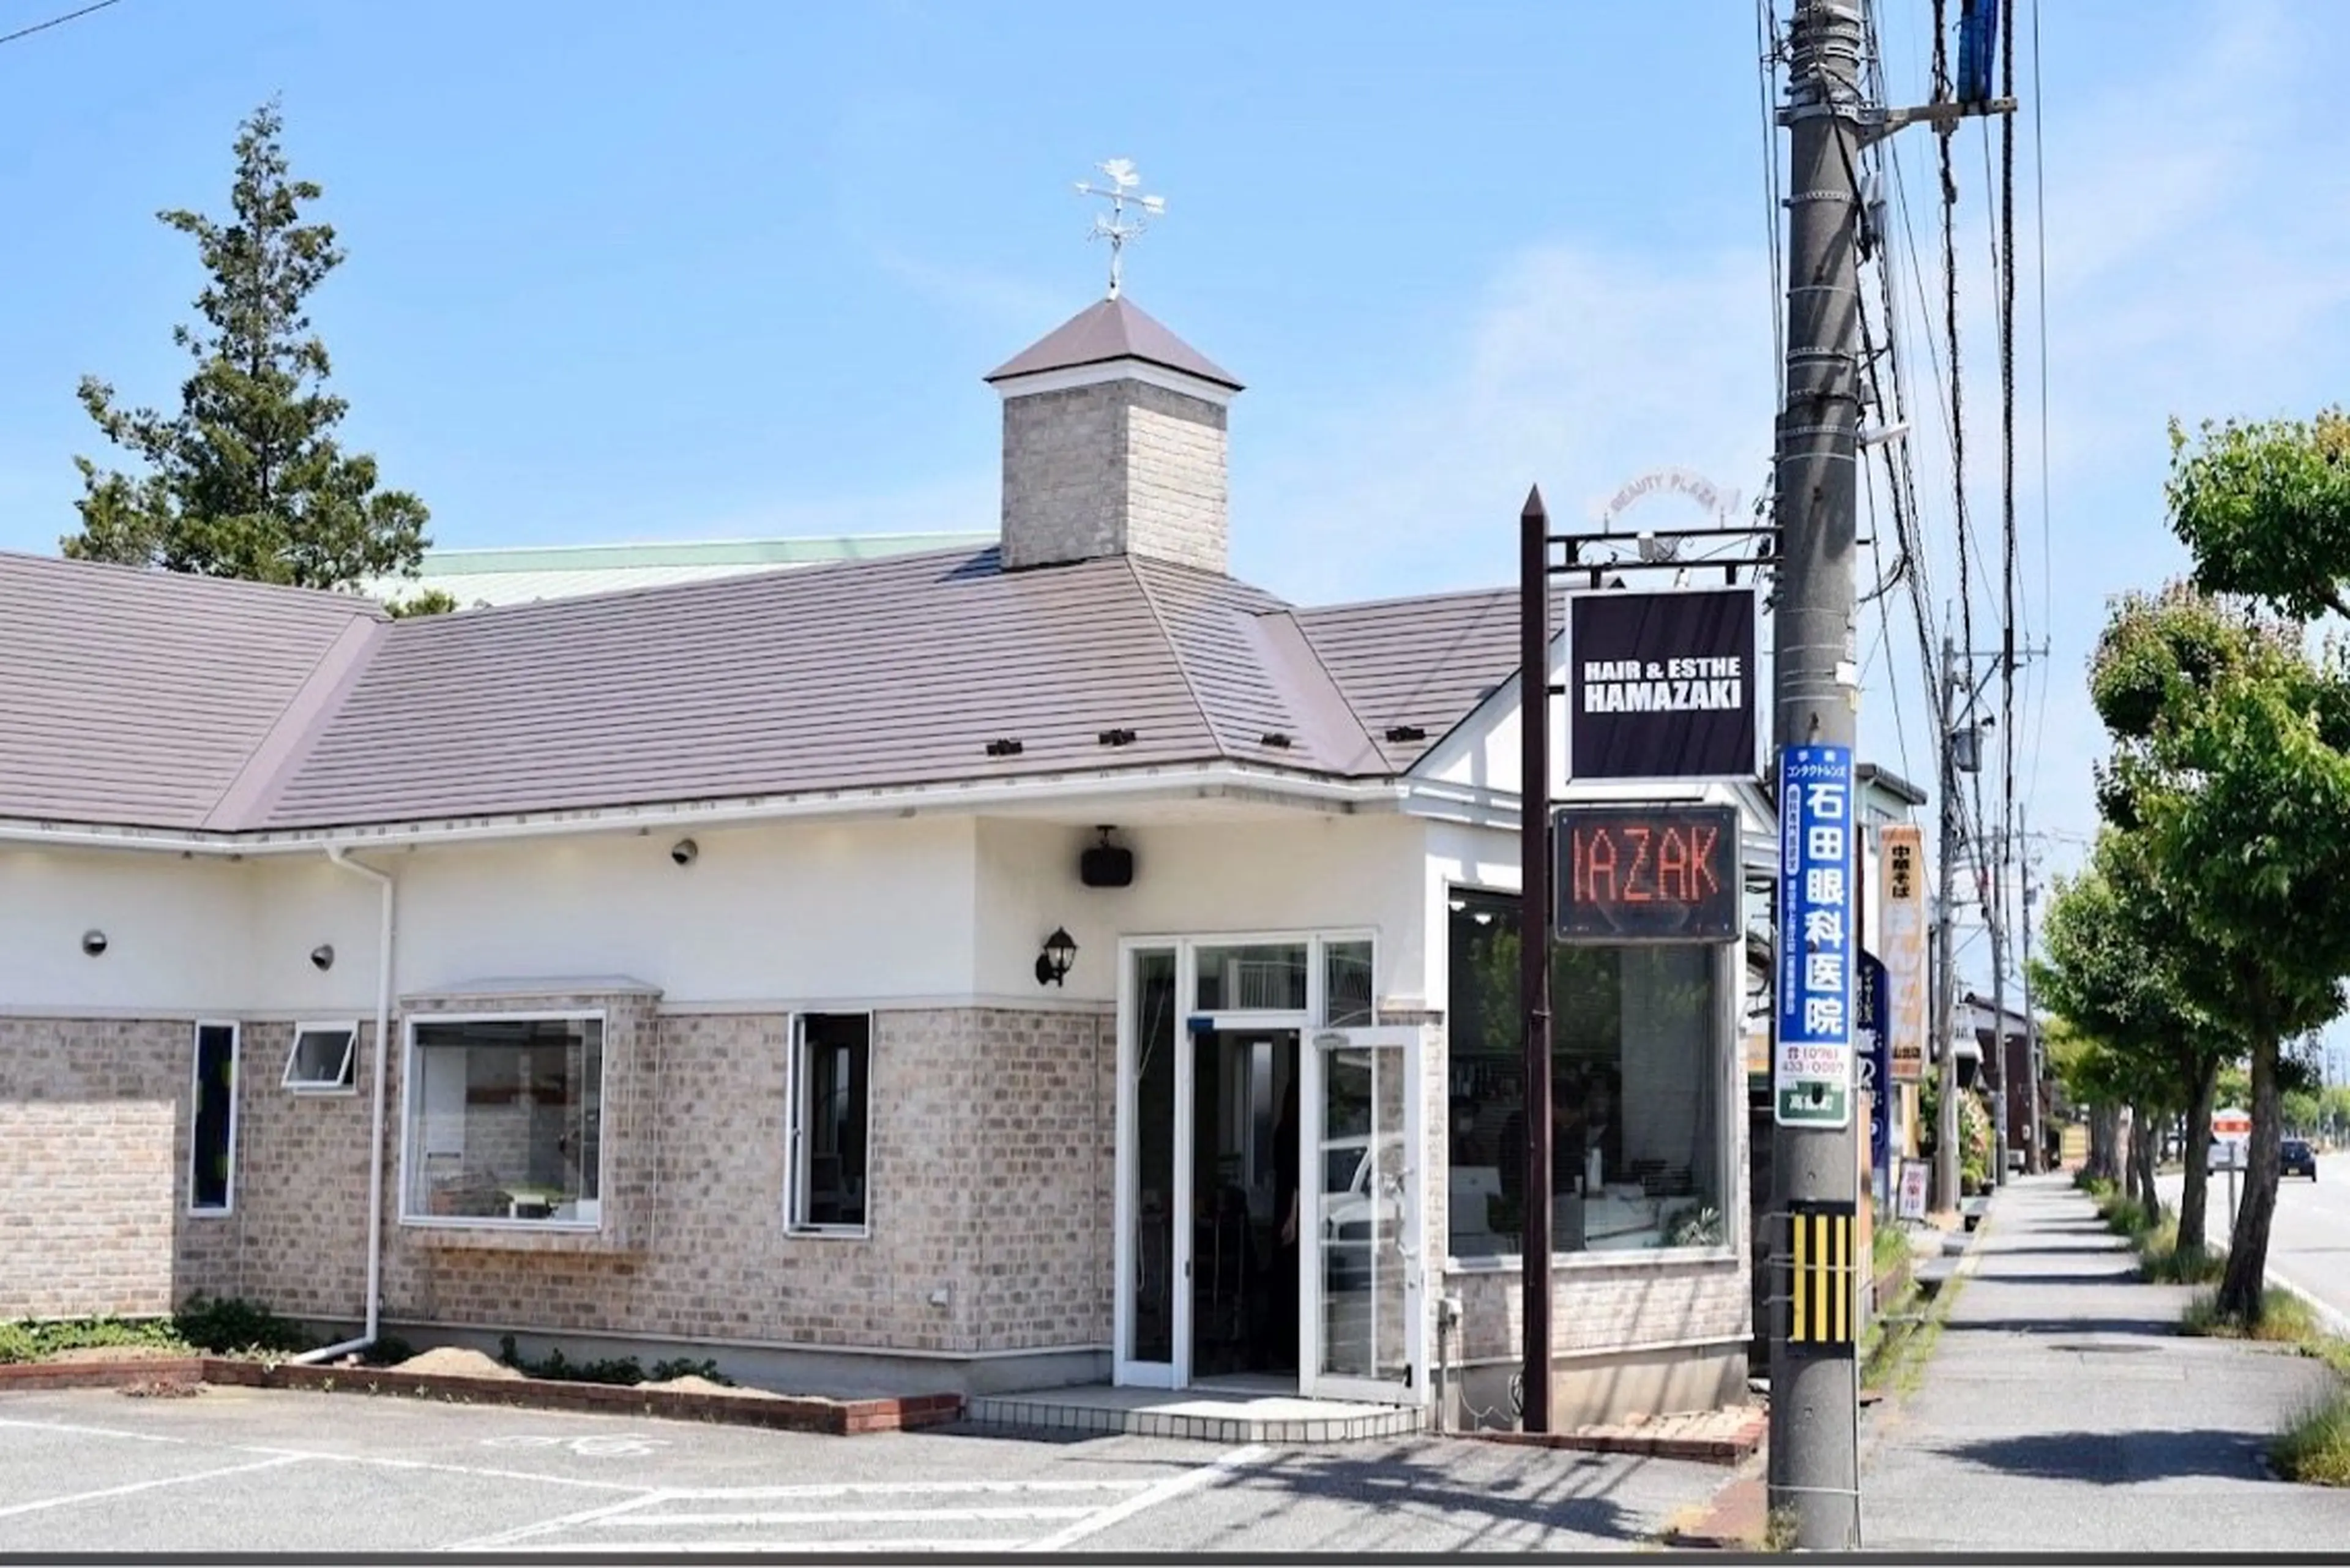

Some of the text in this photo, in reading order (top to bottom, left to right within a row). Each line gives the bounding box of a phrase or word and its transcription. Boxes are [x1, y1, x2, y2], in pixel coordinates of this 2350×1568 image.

[1584, 656, 1741, 682] HAIR & ESTHE
[1584, 679, 1741, 712] HAMAZAKI
[1892, 845, 1910, 898] 中華そば
[1805, 783, 1845, 1035] 石田眼科医院
